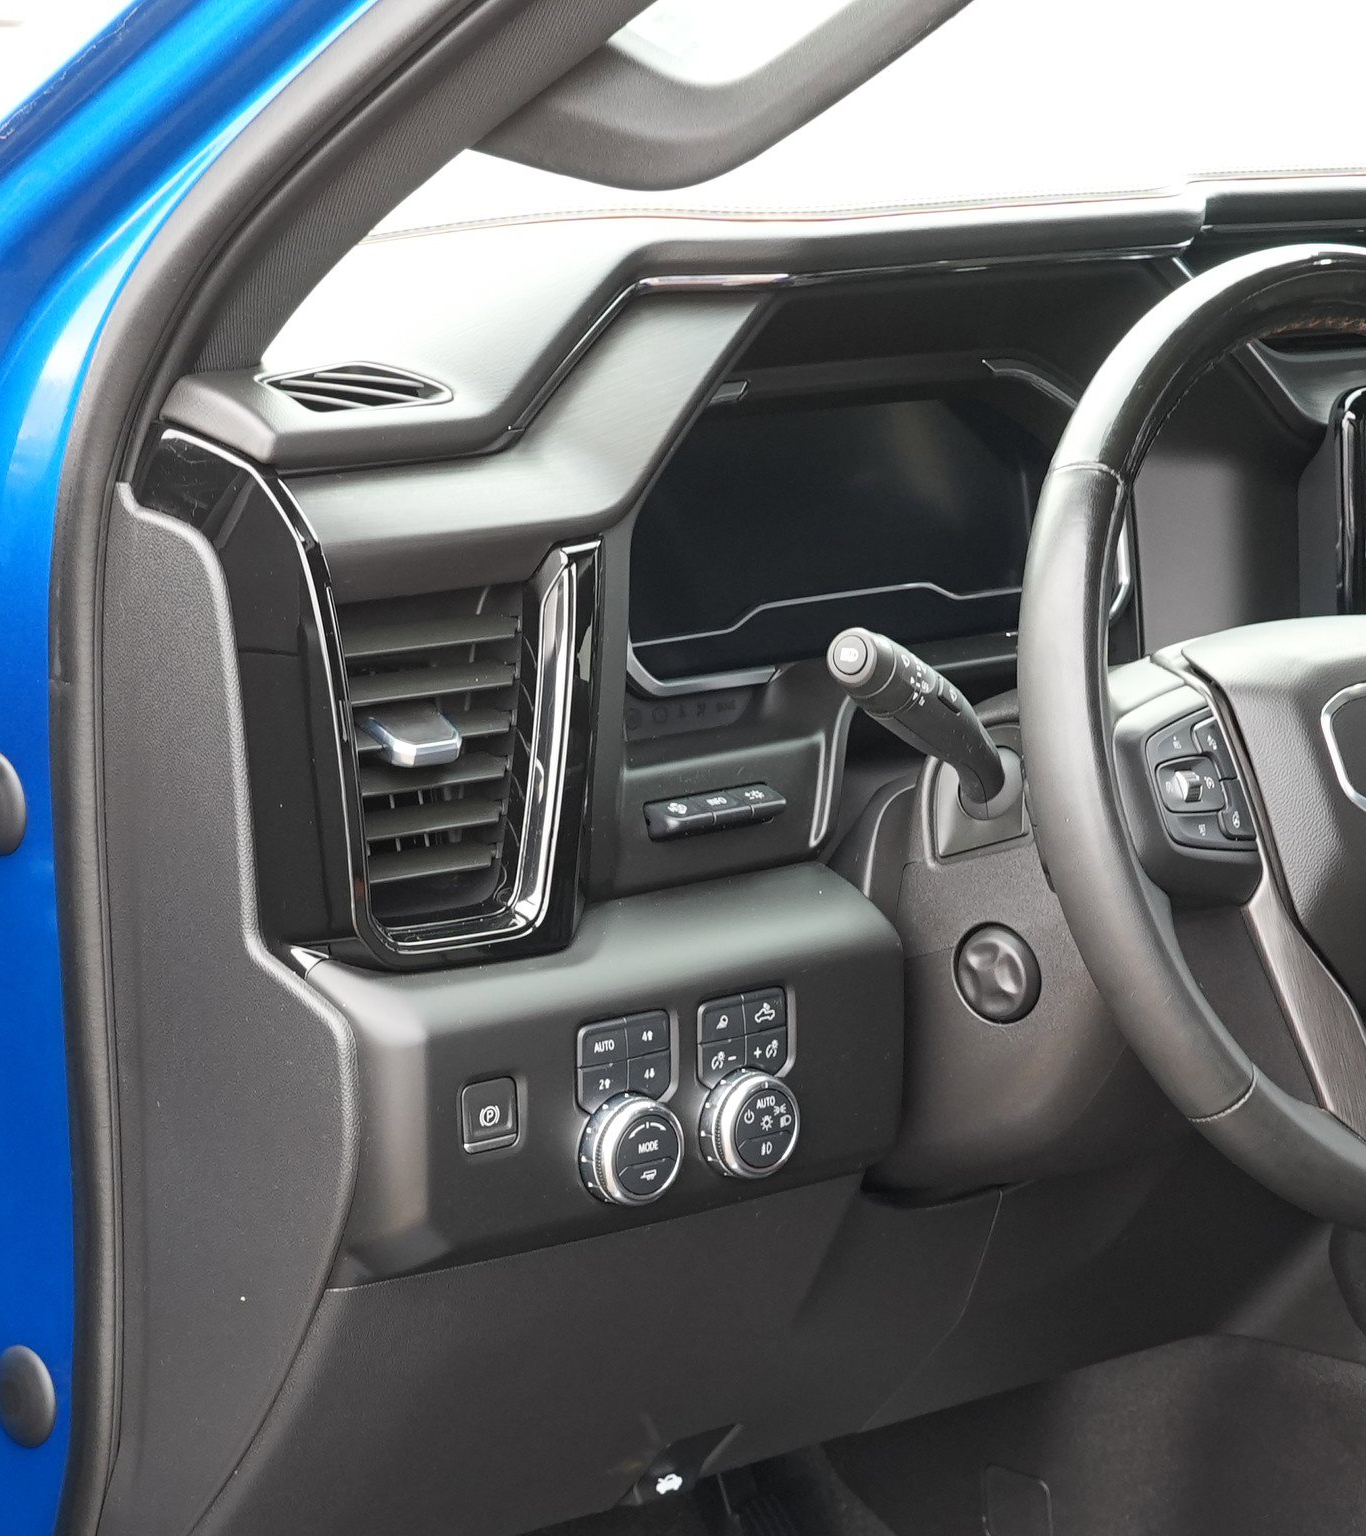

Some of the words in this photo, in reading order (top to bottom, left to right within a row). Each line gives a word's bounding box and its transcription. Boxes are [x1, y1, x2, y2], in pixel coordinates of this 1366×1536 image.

[593, 1039, 615, 1054] AUTO
[756, 1095, 776, 1110] AUTO
[638, 1139, 659, 1154] MODE
